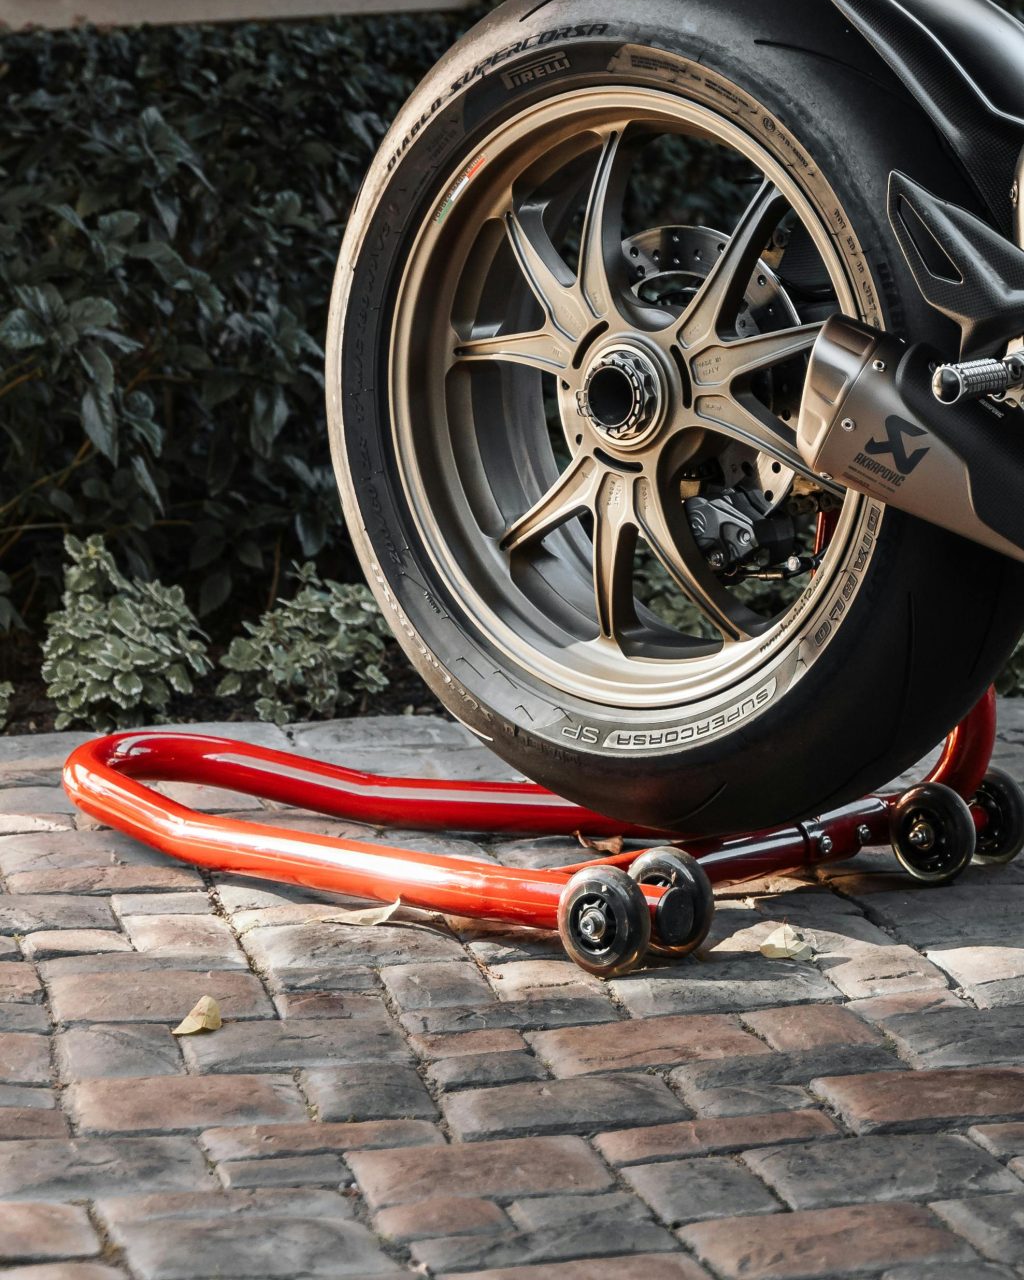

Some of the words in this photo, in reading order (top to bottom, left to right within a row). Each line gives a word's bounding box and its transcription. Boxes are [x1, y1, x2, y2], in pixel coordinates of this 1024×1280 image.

[386, 97, 443, 173] DIABLO
[448, 23, 609, 97] SUPERCORSA
[500, 51, 571, 90] PIRELLI
[814, 505, 881, 647] DIABLO
[561, 724, 601, 745] SP
[615, 688, 770, 747] SUPERCORSA
